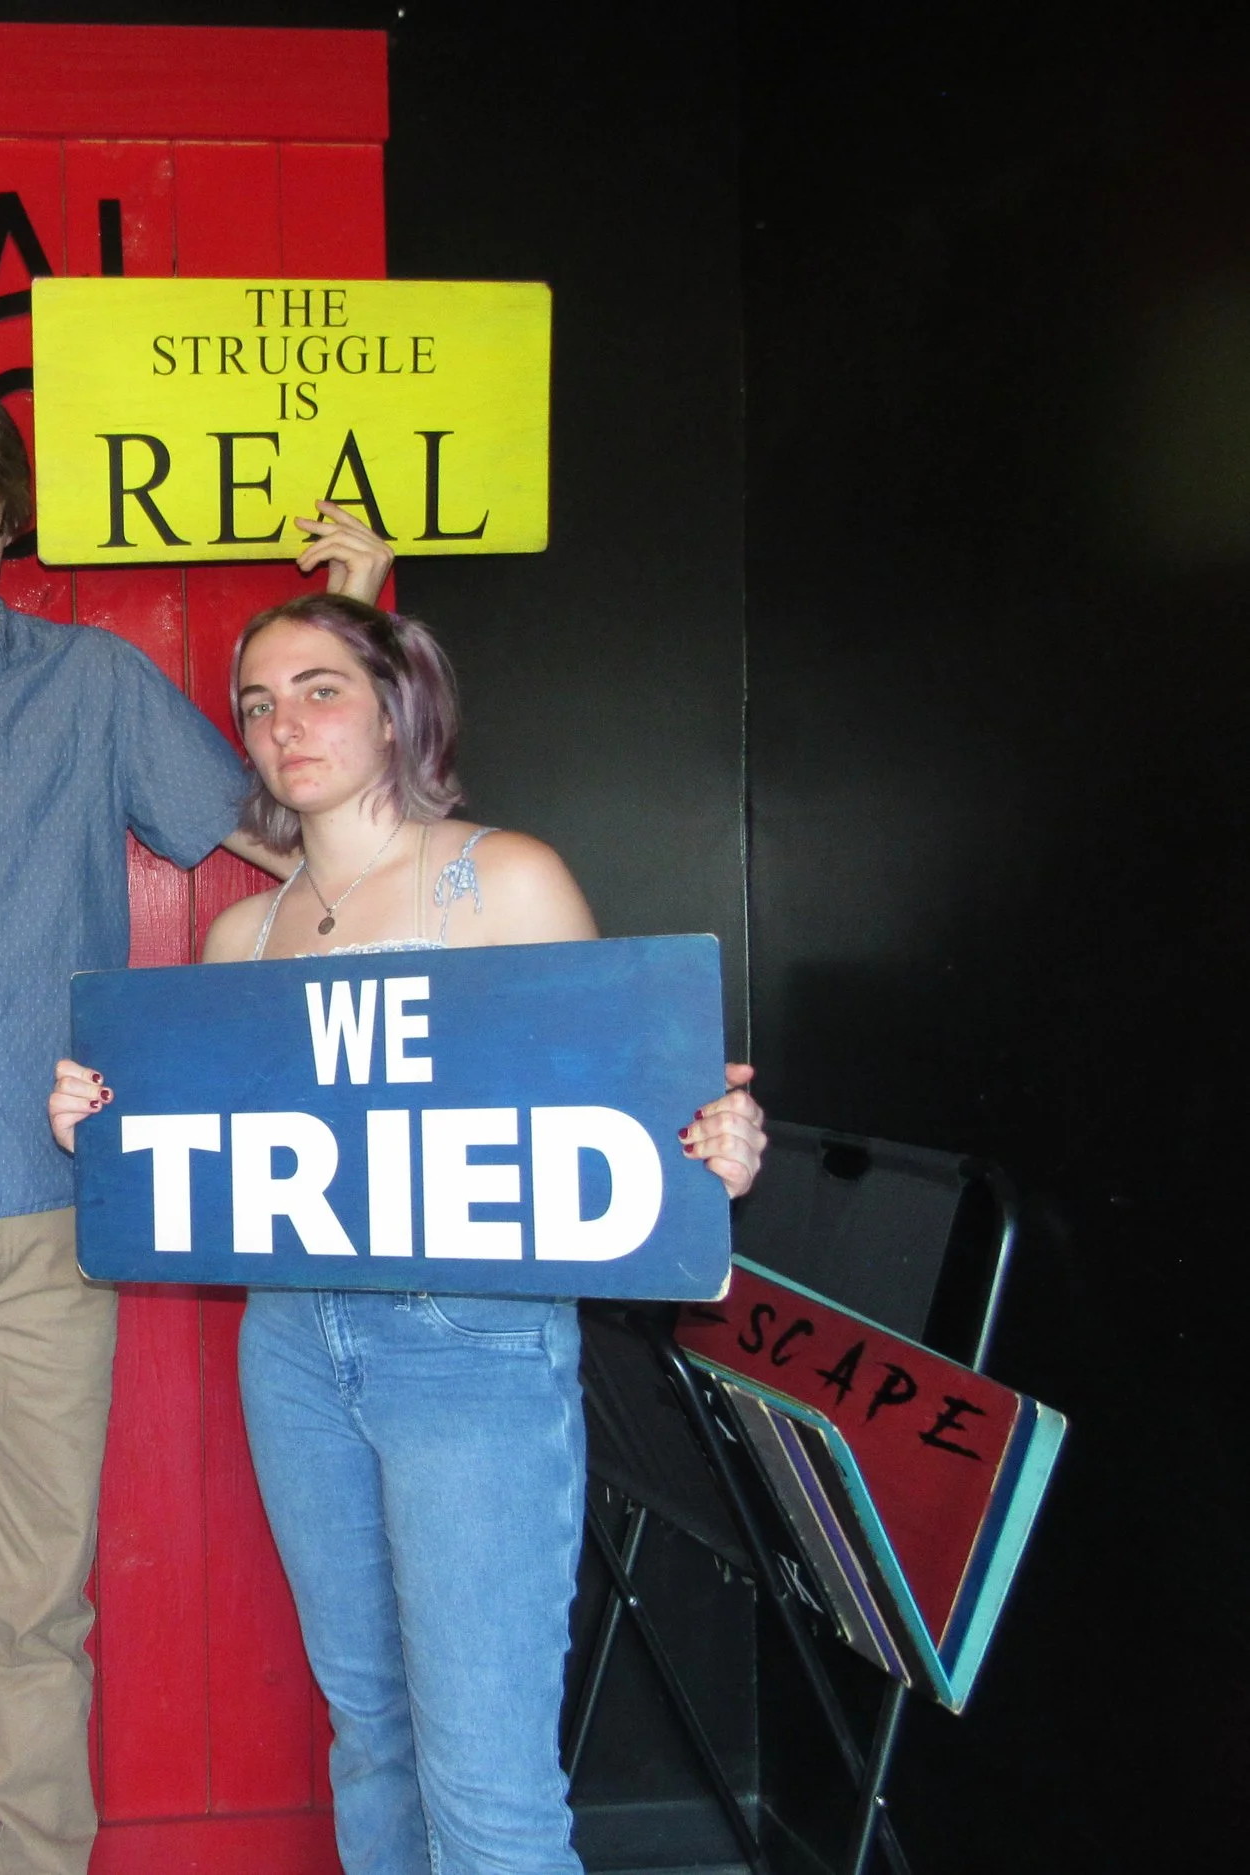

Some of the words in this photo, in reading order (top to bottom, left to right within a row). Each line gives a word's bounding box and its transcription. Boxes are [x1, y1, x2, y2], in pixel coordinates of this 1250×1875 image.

[244, 288, 349, 328] THE
[152, 335, 437, 376] STRUGGLE
[276, 381, 319, 421] IS
[95, 428, 490, 549] REAL
[304, 975, 433, 1086] WE
[120, 1105, 663, 1262] TRIED
